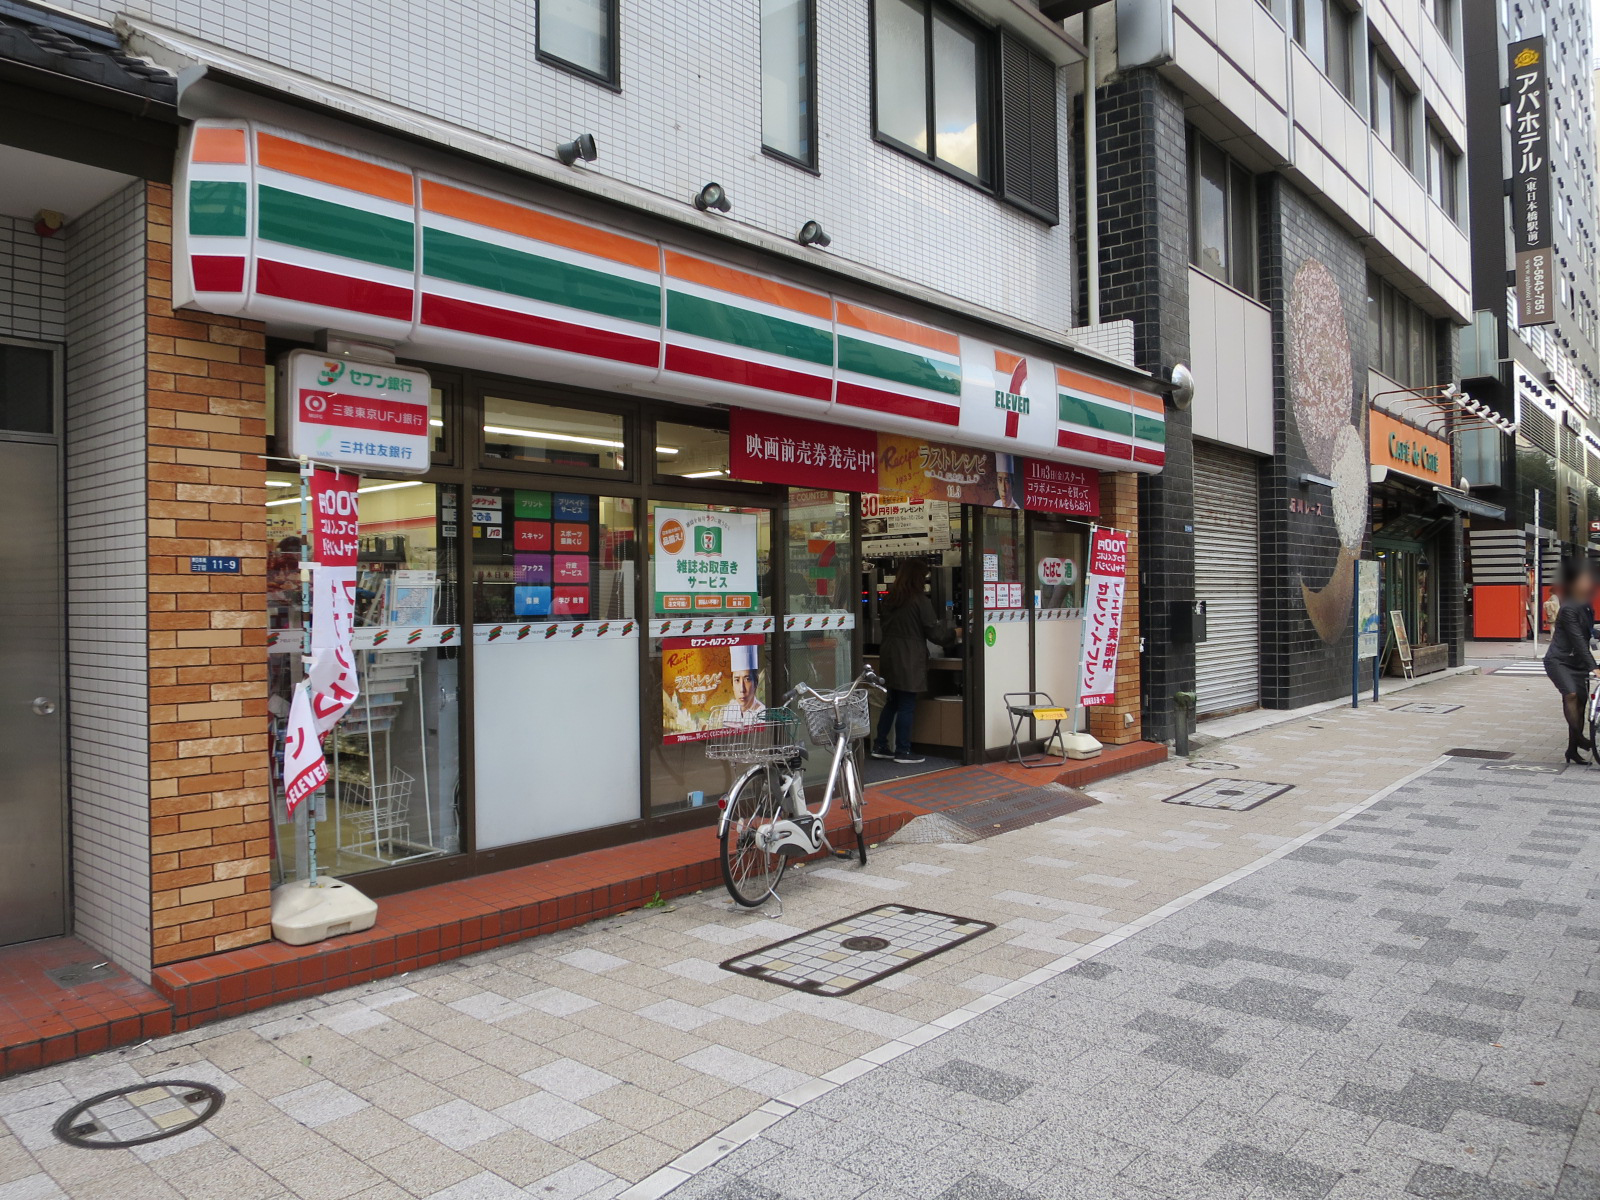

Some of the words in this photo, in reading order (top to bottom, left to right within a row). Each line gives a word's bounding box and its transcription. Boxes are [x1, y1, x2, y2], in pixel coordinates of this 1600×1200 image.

[1515, 71, 1542, 174] アパホテル
[1533, 255, 1545, 315] 03-5643-7551
[349, 369, 412, 393] セブン銀行
[332, 404, 423, 426] 三菱東京UFJ銀行
[340, 440, 413, 460] 三井住友銀行
[746, 433, 875, 474] 映画前売券発売中!
[919, 445, 987, 475] ラストレシピ
[1032, 463, 1086, 484] 11月3日(金)スタート
[1028, 482, 1089, 500] コラボメニューを買って
[561, 506, 583, 514] サービス
[861, 495, 878, 517] 30
[879, 506, 899, 515] 円引券
[1026, 495, 1092, 513] クリアファイルをもらおう!
[212, 560, 236, 570] 11-9
[677, 559, 738, 574] 雑誌お取置き
[1043, 561, 1062, 578] たばこ
[1065, 563, 1073, 578] 酒
[688, 576, 727, 588] サービス
